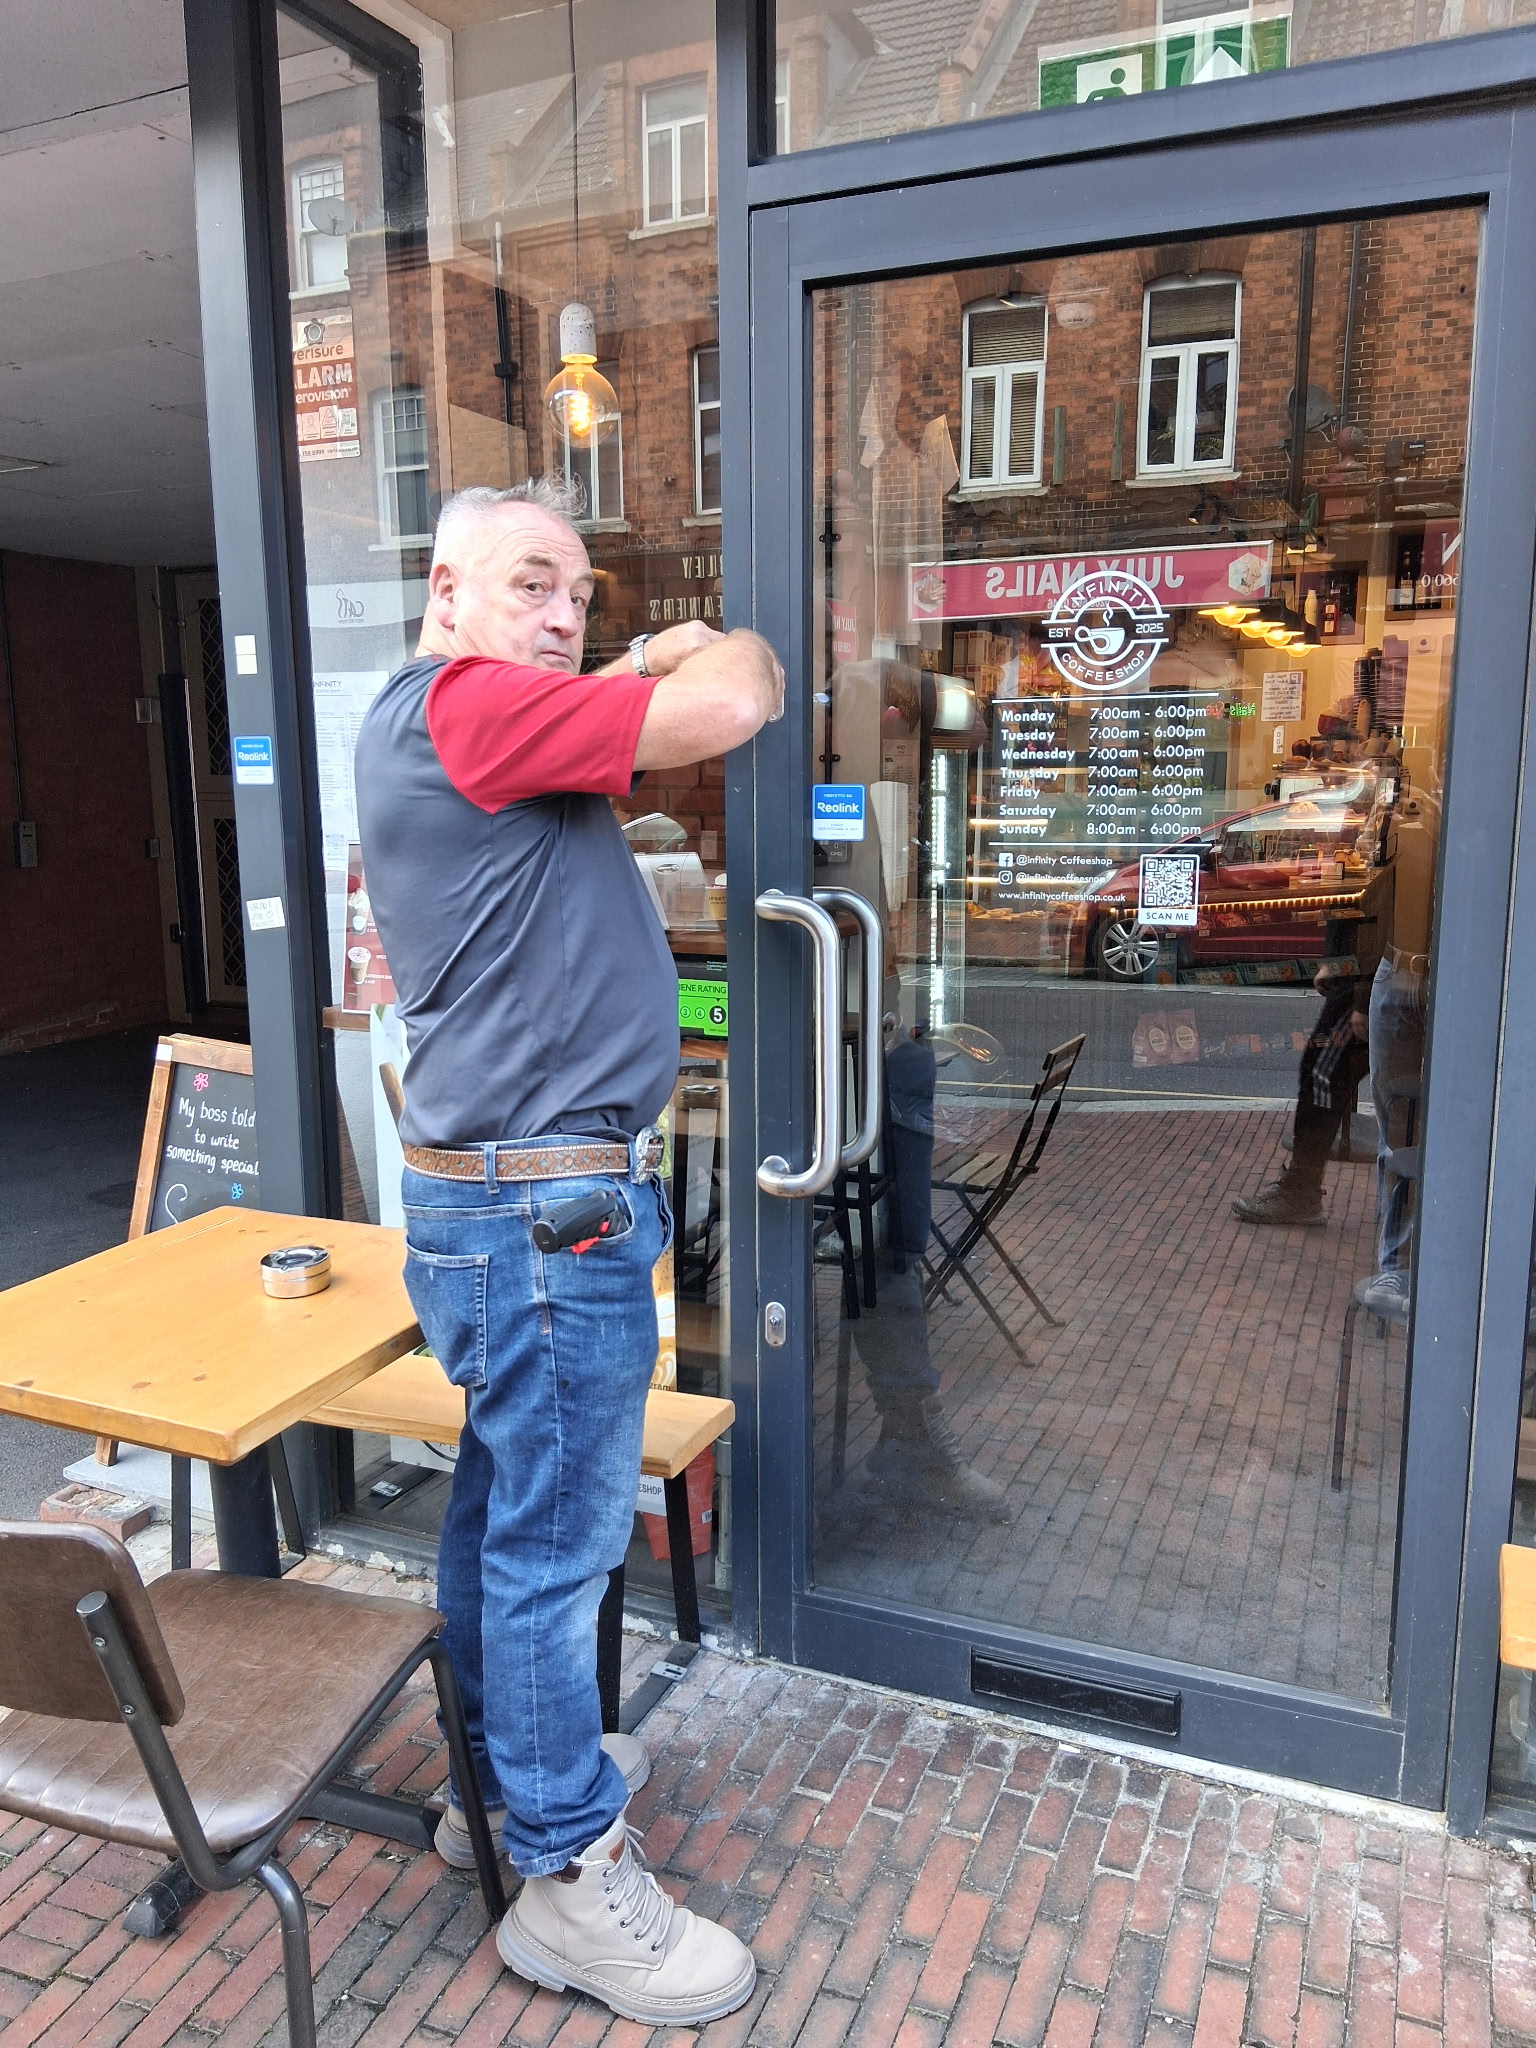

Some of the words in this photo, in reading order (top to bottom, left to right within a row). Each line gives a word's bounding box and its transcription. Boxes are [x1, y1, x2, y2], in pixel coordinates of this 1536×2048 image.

[295, 362, 353, 390] LARM
[1064, 581, 1150, 614] INFINITY
[1048, 628, 1071, 638] EST
[1135, 623, 1164, 633] 2025
[1062, 650, 1146, 681] COFFEESHOP
[1001, 709, 1055, 725] Monday
[1090, 707, 1141, 720] 7:00am
[1155, 705, 1207, 720] 6:00pm
[1001, 728, 1055, 745] Tuesday
[1089, 727, 1140, 740] 7:00am
[1154, 725, 1206, 740] 6:00pm
[238, 751, 270, 761] Reolink
[1001, 747, 1075, 764] Wednesday
[1088, 746, 1139, 760] 7:00am
[1153, 745, 1205, 760] 6:00pm
[1001, 766, 1060, 781] Thursday
[1088, 766, 1138, 778] 7:00am
[1152, 764, 1204, 779] 6:00pm
[1000, 785, 1041, 800] Friday
[1087, 784, 1137, 797] 7:00am
[1151, 784, 1203, 799] 6:00pm
[817, 802, 860, 813] Reolink
[999, 804, 1057, 819] Saturday
[1086, 803, 1136, 816] 7:00am
[1150, 804, 1202, 818] 6:00pm
[998, 823, 1047, 837] Sunday
[1086, 823, 1136, 835] 8:00am
[1150, 823, 1201, 837] 6:00pm
[1016, 854, 1057, 867] @infinity
[1060, 855, 1113, 867] Coffeeshop
[998, 892, 1126, 903] www.infinitycoffeeshop.co.uk
[1146, 912, 1173, 920] SCAN
[1176, 912, 1190, 921] ME
[698, 984, 727, 994] RATING
[713, 1007, 723, 1023] 5
[178, 1097, 196, 1127] My
[200, 1101, 227, 1124] boss
[231, 1106, 256, 1129] told
[194, 1128, 206, 1144] to
[211, 1134, 240, 1150] write
[166, 1144, 217, 1174] something
[221, 1155, 260, 1176] special
